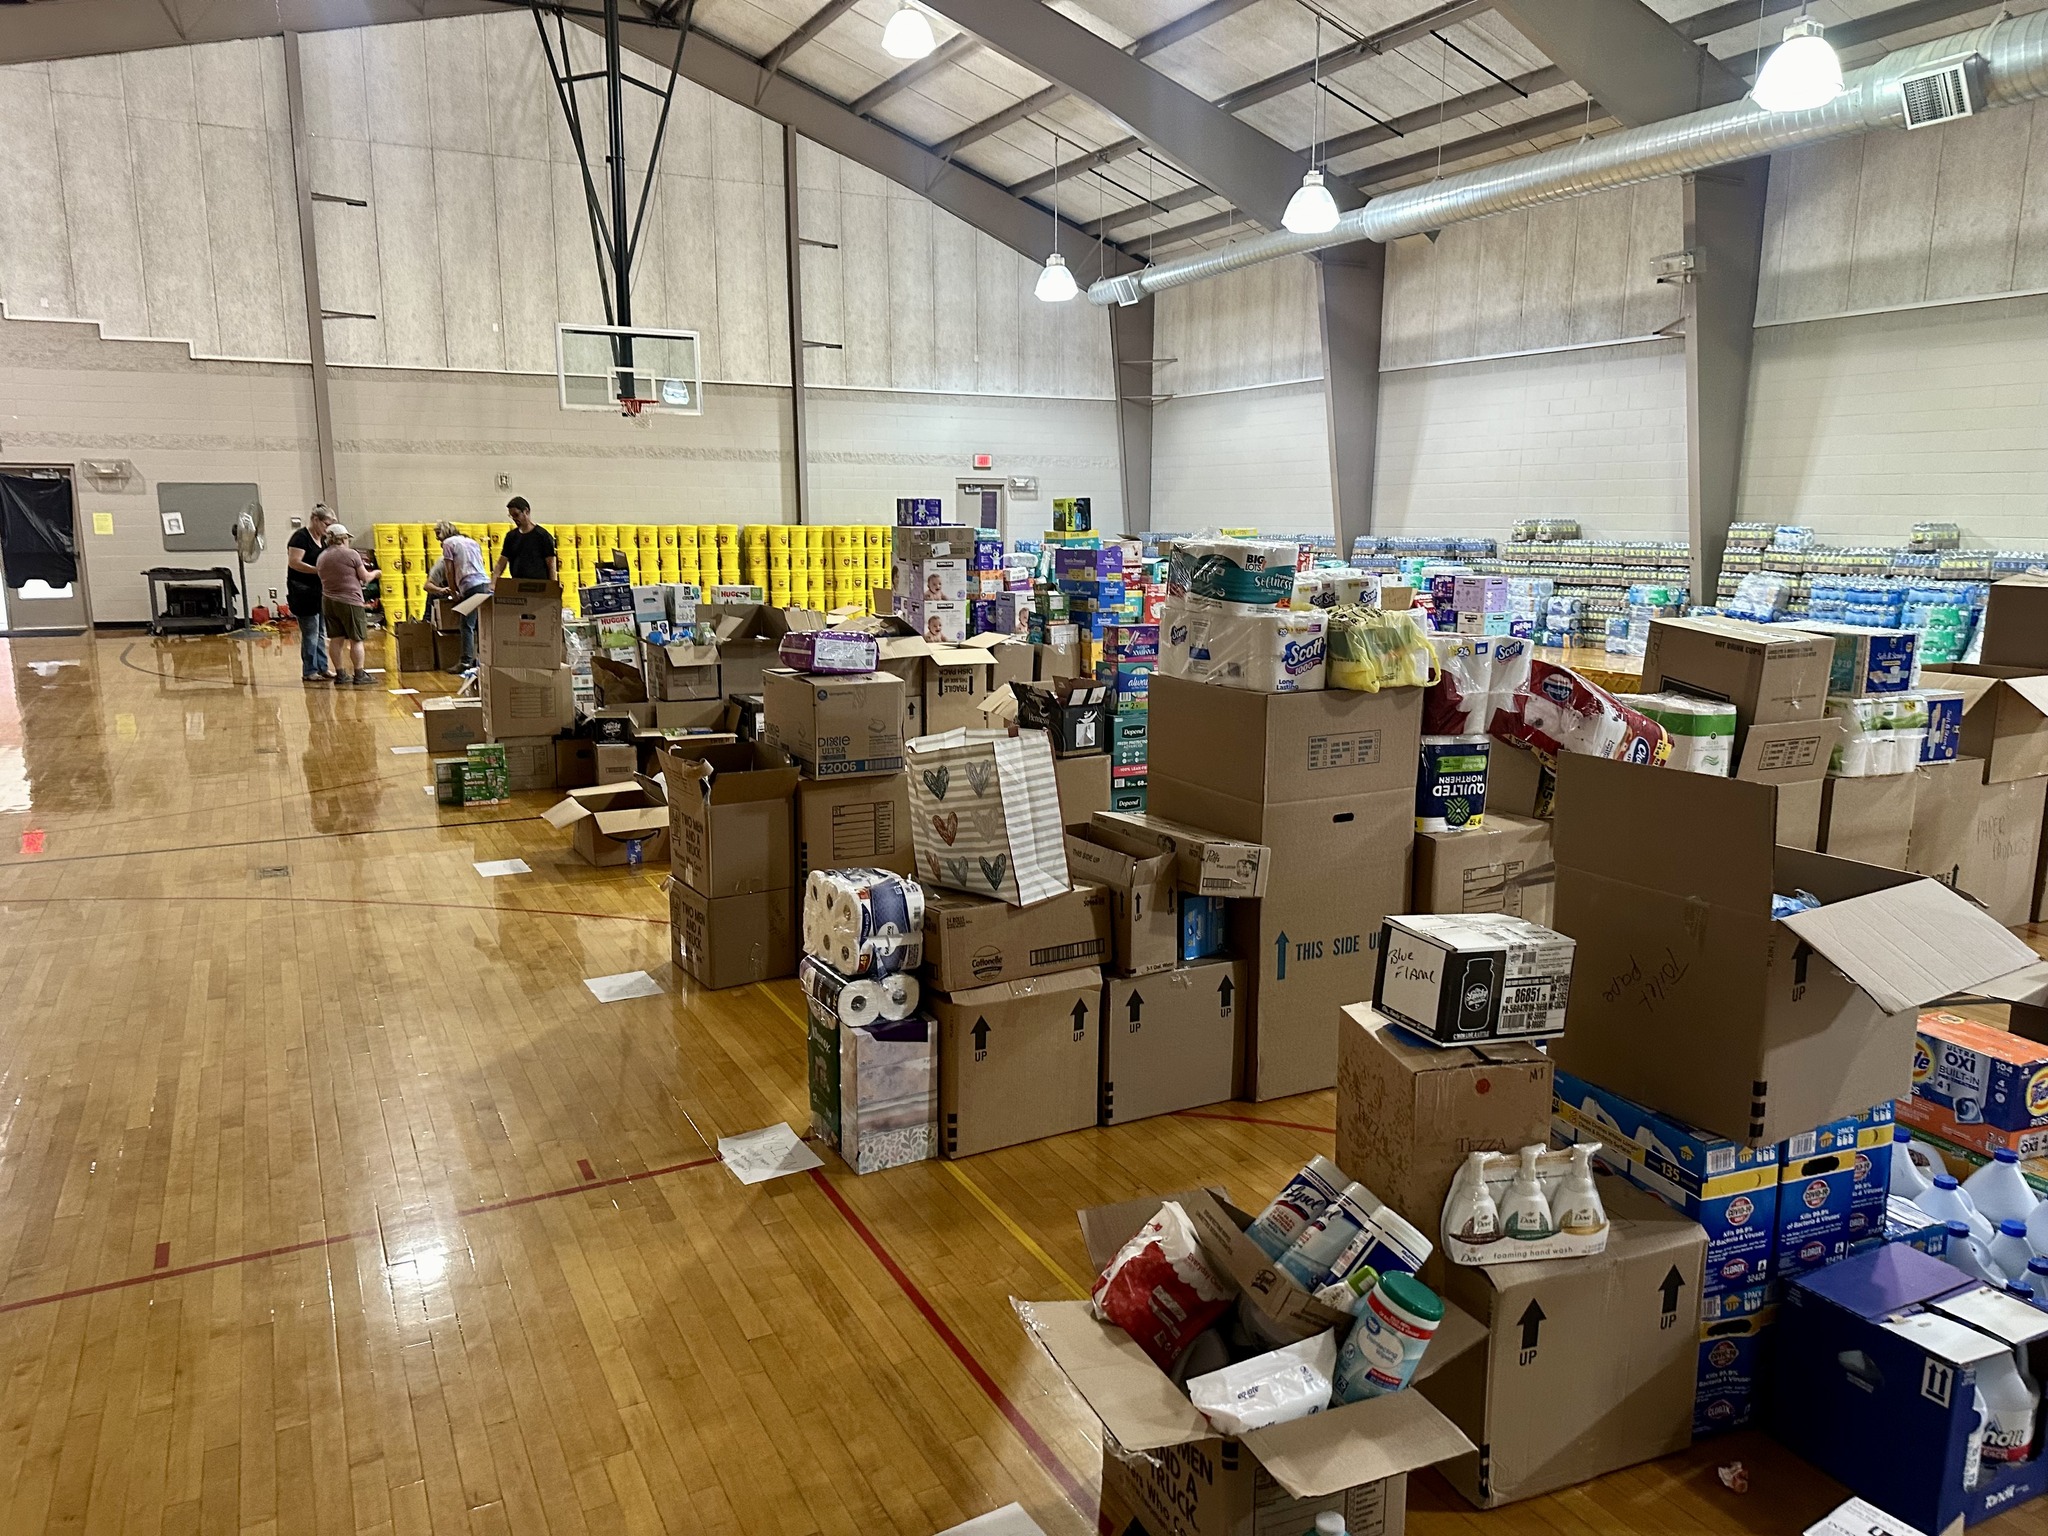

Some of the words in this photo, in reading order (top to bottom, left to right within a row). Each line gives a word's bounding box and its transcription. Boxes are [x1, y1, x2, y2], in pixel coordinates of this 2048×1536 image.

[1246, 554, 1265, 564] BIG
[1254, 575, 1293, 591] Softness
[600, 616, 631, 625] HUGGIES
[1289, 637, 1324, 665] Scott
[1458, 647, 1470, 656] 24
[1498, 640, 1521, 660] Scott
[1745, 645, 1762, 656] CUPS
[1295, 662, 1314, 676] 1000
[944, 684, 968, 694] FRAGILE
[1276, 684, 1298, 692] Lasting
[1123, 727, 1145, 737] Depend
[821, 747, 847, 755] ULTRA
[820, 761, 857, 774] 32006
[1438, 775, 1483, 784] NORTHERN
[1432, 783, 1485, 797] QUILTED
[1118, 799, 1140, 807] Depend
[681, 812, 692, 827] TWO
[686, 829, 696, 843] AND
[682, 902, 693, 916] TWO
[694, 908, 706, 926] MEN
[686, 919, 696, 933] AND
[1296, 941, 1323, 961] THIS
[1333, 935, 1360, 955] SIDE
[972, 955, 1003, 969] Cottonelle
[1387, 947, 1414, 964] Blue
[1514, 987, 1542, 1003] 86851
[1792, 985, 1806, 1002] UP
[1220, 1007, 1232, 1018] UP
[1129, 1022, 1141, 1033] UP
[1073, 1031, 1085, 1043] UP
[975, 1051, 987, 1062] UP
[1946, 1044, 1976, 1060] ULTRA
[1945, 1051, 1976, 1074] OXI
[1995, 1061, 2013, 1074] 104
[1529, 1067, 1545, 1084] MT
[1939, 1065, 1980, 1086] BUILT-IN
[1821, 1137, 1833, 1148] UP
[1740, 1154, 1752, 1163] UP
[1661, 1162, 1681, 1182] 135
[1284, 1186, 1322, 1211] Lysol
[1805, 1188, 1829, 1200] COVID-19
[1574, 1213, 1592, 1221] Dove
[1728, 1205, 1753, 1218] COVID-19
[1812, 1209, 1829, 1218] 99.9%
[1477, 1219, 1492, 1229] Dove
[1520, 1216, 1538, 1225] Dove
[1794, 1219, 1816, 1229] Bacteria
[1716, 1236, 1739, 1247] Bacteria
[1460, 1253, 1484, 1263] Dove
[1493, 1251, 1528, 1260] foaming
[1530, 1248, 1551, 1256] hand
[1552, 1246, 1574, 1254] wash
[1801, 1247, 1823, 1260] CLOROX
[1187, 1252, 1213, 1280] Everyday
[1722, 1262, 1746, 1276] CLOROX
[1660, 1315, 1677, 1329] UP
[1366, 1333, 1398, 1359] Disinfecting
[1375, 1348, 1395, 1364] Wipes
[1519, 1351, 1537, 1366] UP
[1699, 1379, 1722, 1387] Bacteria
[1177, 1442, 1213, 1486] MEN
[1186, 1472, 1199, 1502] A
[1147, 1480, 1170, 1521] Who
[1150, 1463, 1200, 1534] TRUCK
